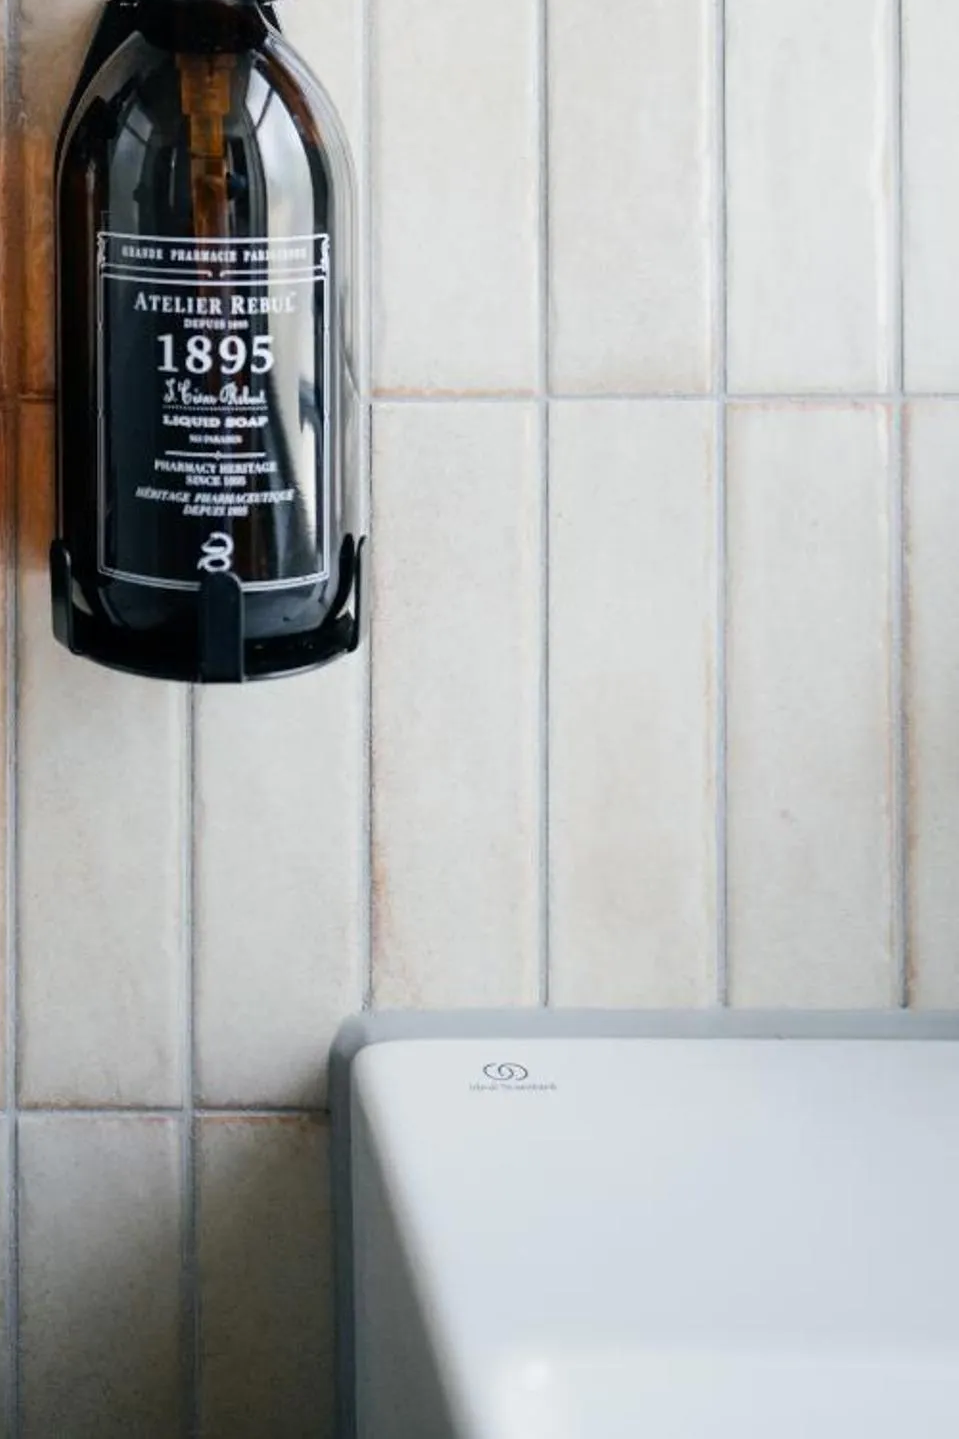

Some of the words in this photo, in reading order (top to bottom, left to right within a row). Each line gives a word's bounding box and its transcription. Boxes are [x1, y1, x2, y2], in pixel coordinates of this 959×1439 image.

[171, 249, 236, 262] PHARMACIE
[134, 292, 222, 314] ATELIER
[157, 334, 274, 374] 1895
[163, 415, 221, 428] LIQUID
[225, 416, 269, 428] SOAP
[155, 460, 216, 474] PHARMACY
